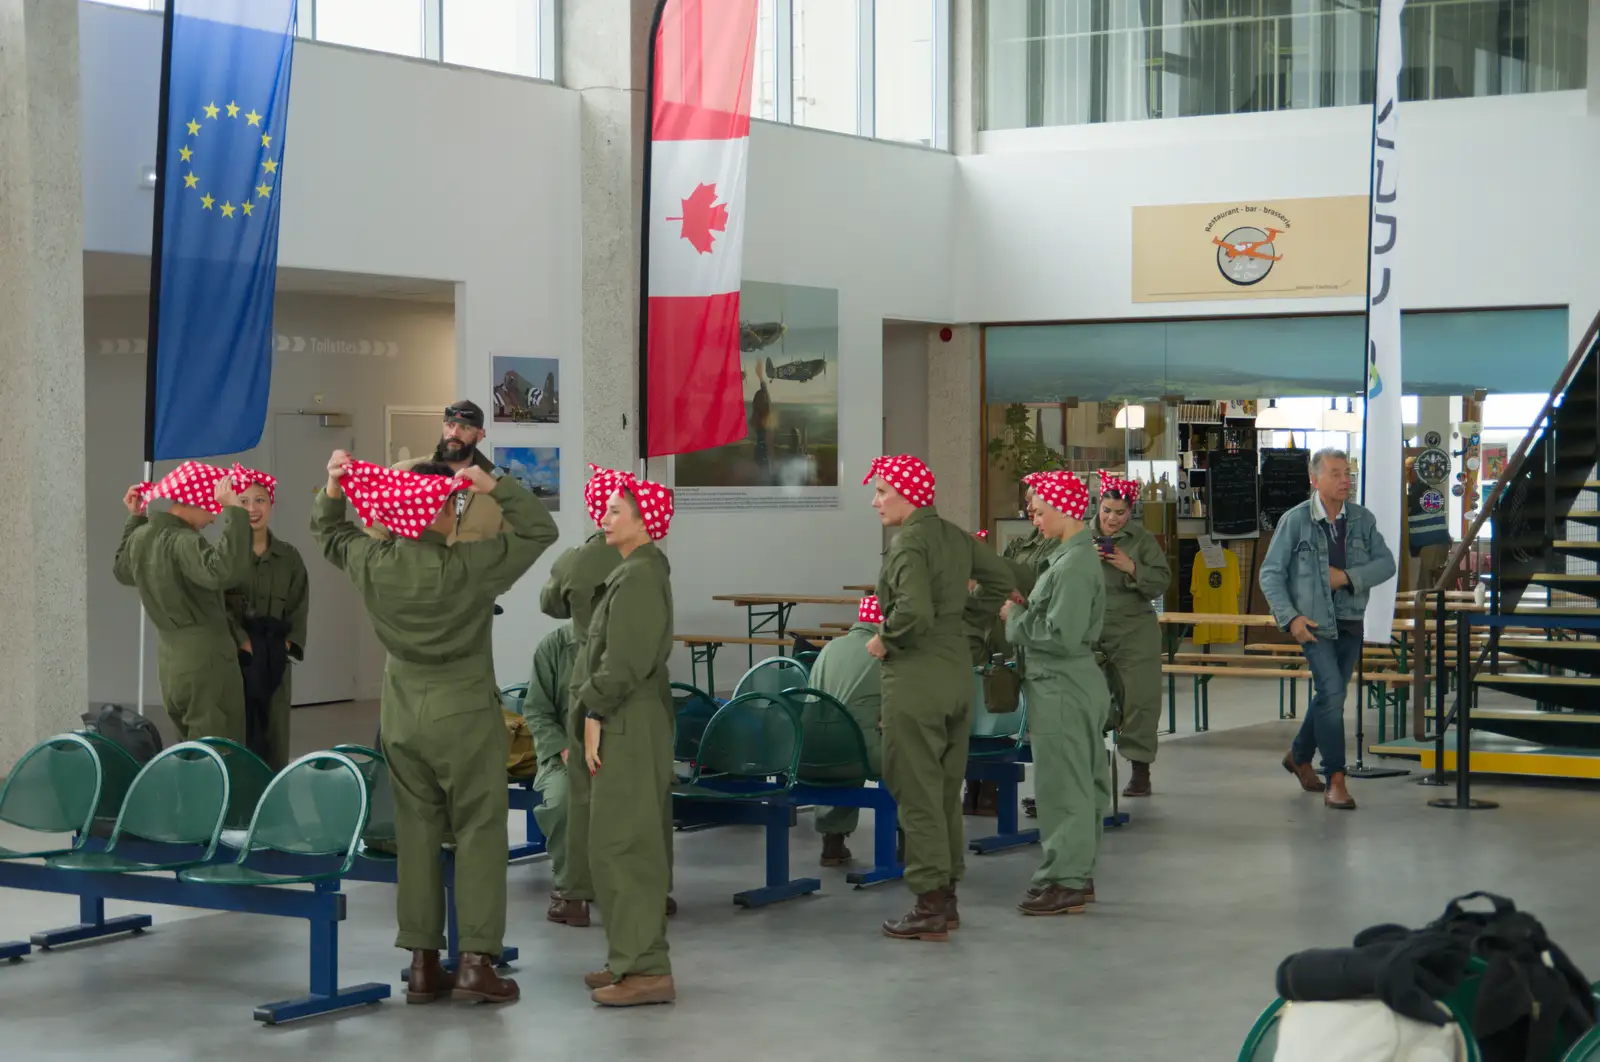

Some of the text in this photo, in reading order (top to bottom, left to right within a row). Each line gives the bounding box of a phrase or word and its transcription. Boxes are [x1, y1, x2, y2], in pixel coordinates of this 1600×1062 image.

[1204, 207, 1240, 232] Restaurant
[1245, 205, 1257, 213] bar
[1263, 206, 1292, 229] brasserie
[309, 337, 357, 355] Toilettes
